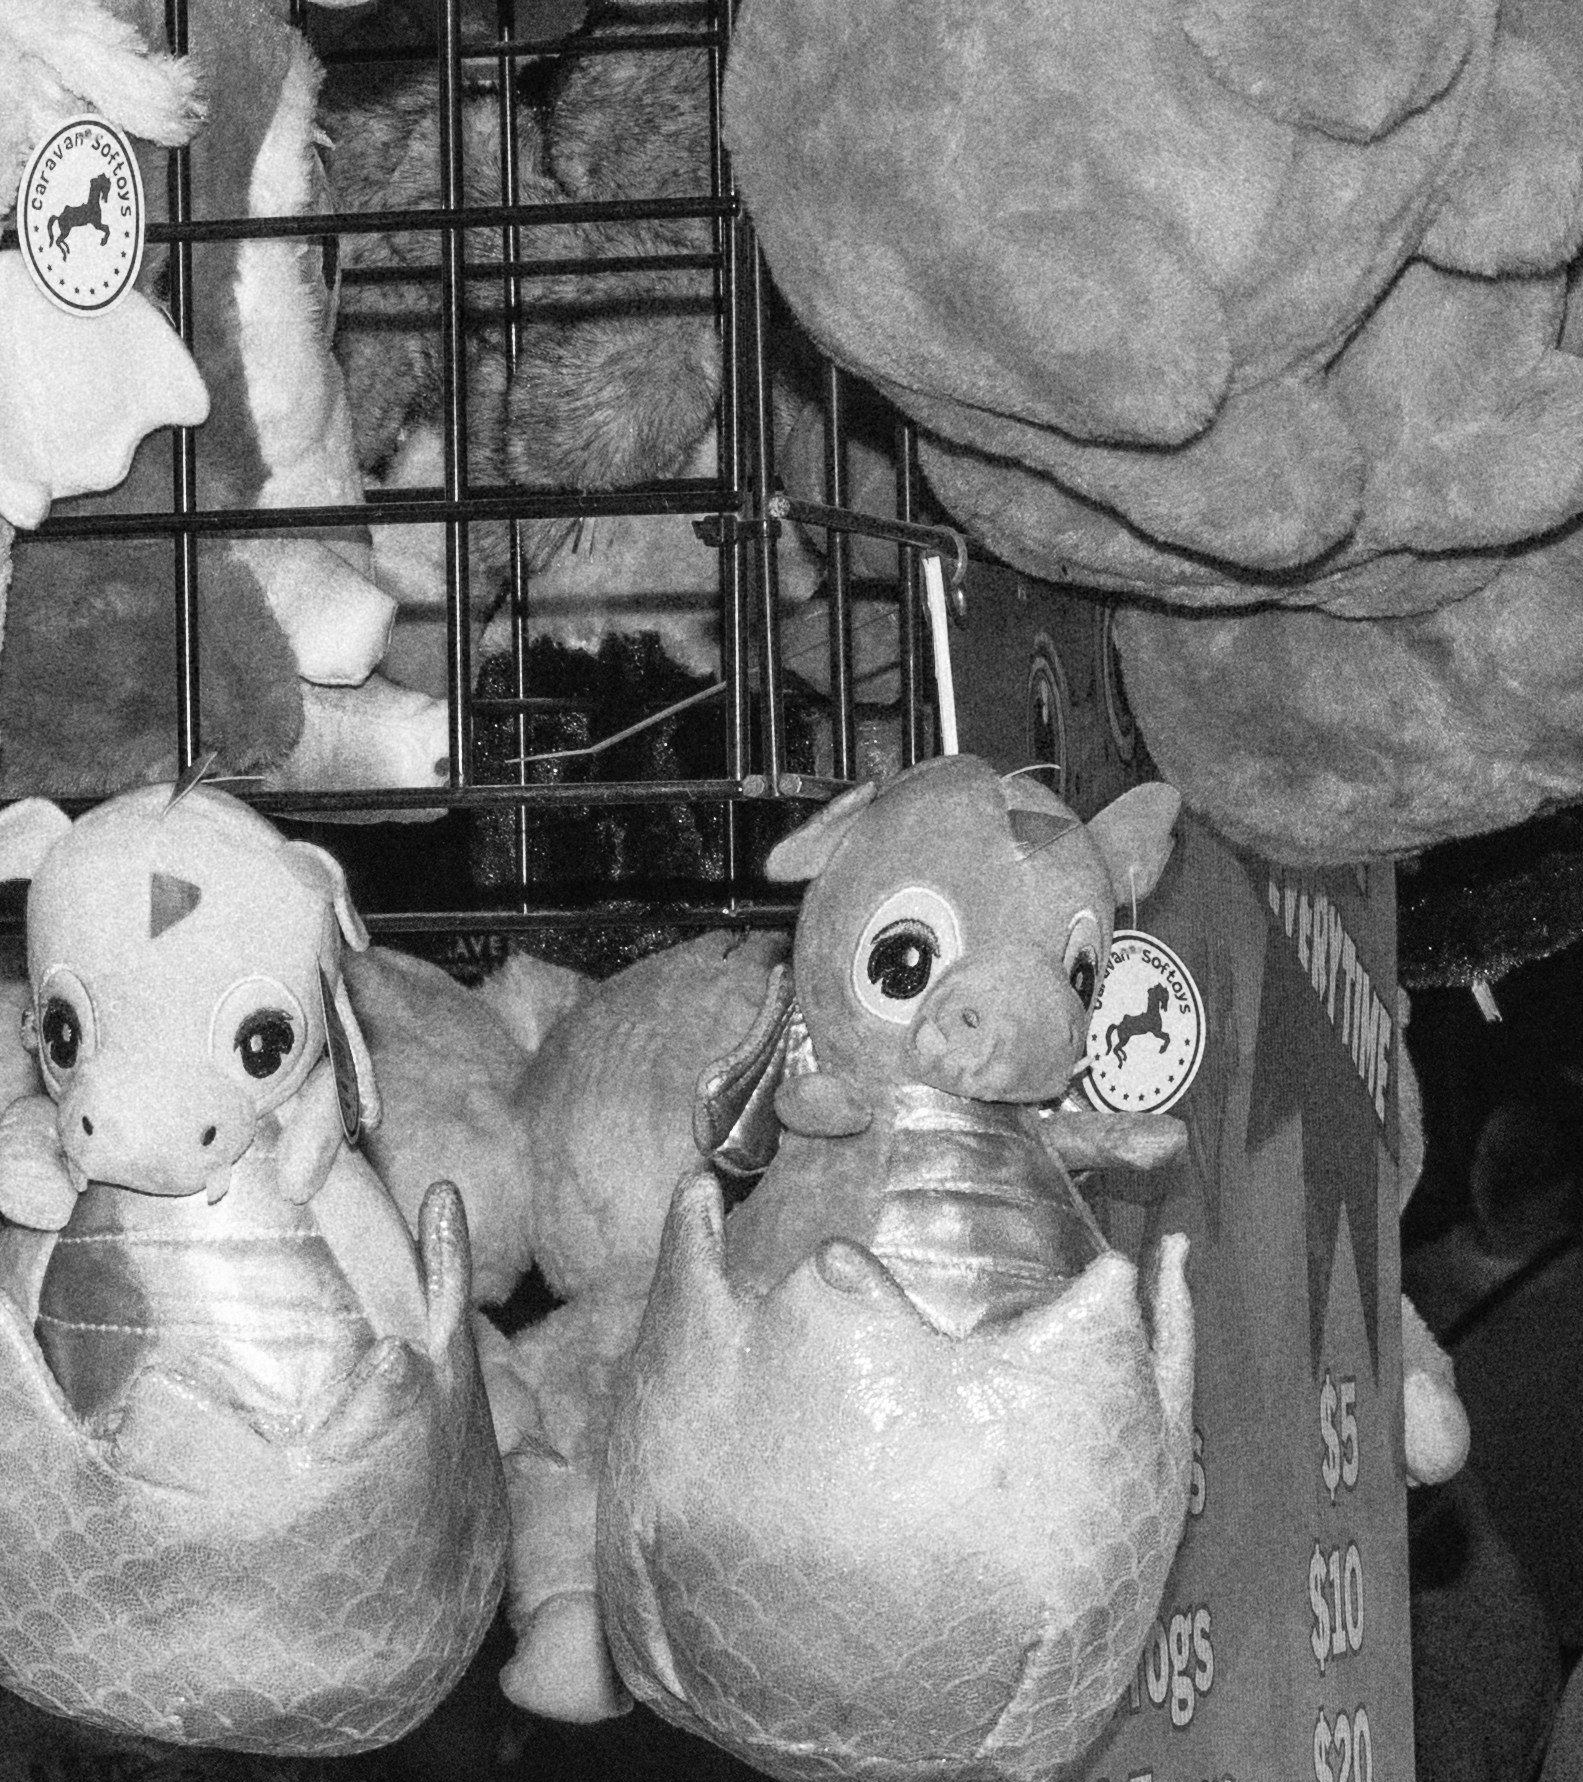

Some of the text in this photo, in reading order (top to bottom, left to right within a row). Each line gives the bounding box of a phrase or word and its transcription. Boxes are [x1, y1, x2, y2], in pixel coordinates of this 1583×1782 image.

[1141, 949, 1192, 1015] Softoys
[1319, 1373, 1359, 1501] $5
[1309, 1543, 1365, 1672] $10
